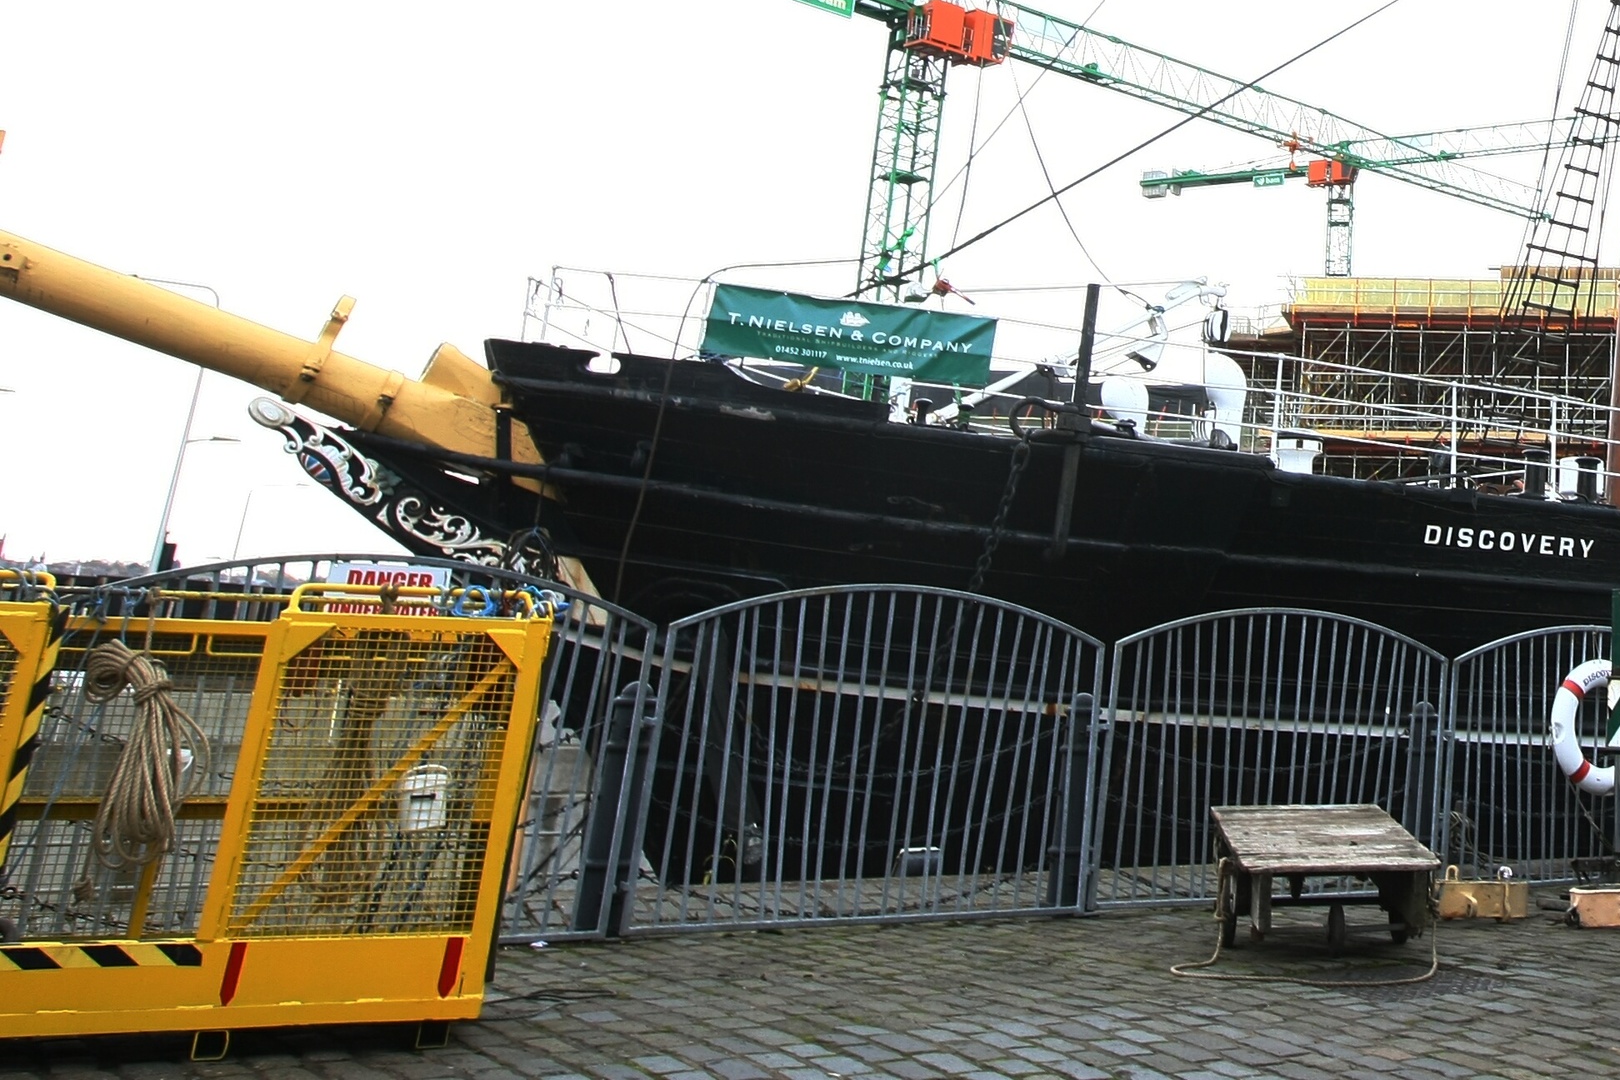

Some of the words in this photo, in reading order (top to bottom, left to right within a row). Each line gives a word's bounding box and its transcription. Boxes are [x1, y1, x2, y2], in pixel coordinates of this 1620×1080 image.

[851, 330, 863, 341] &
[872, 332, 973, 353] COMPANY
[775, 345, 799, 355] 01452
[801, 348, 828, 359] 301117
[835, 354, 914, 370] www.tnielsen.co.uk
[1424, 524, 1594, 558] DISCOVERY
[347, 570, 433, 587] DANGER
